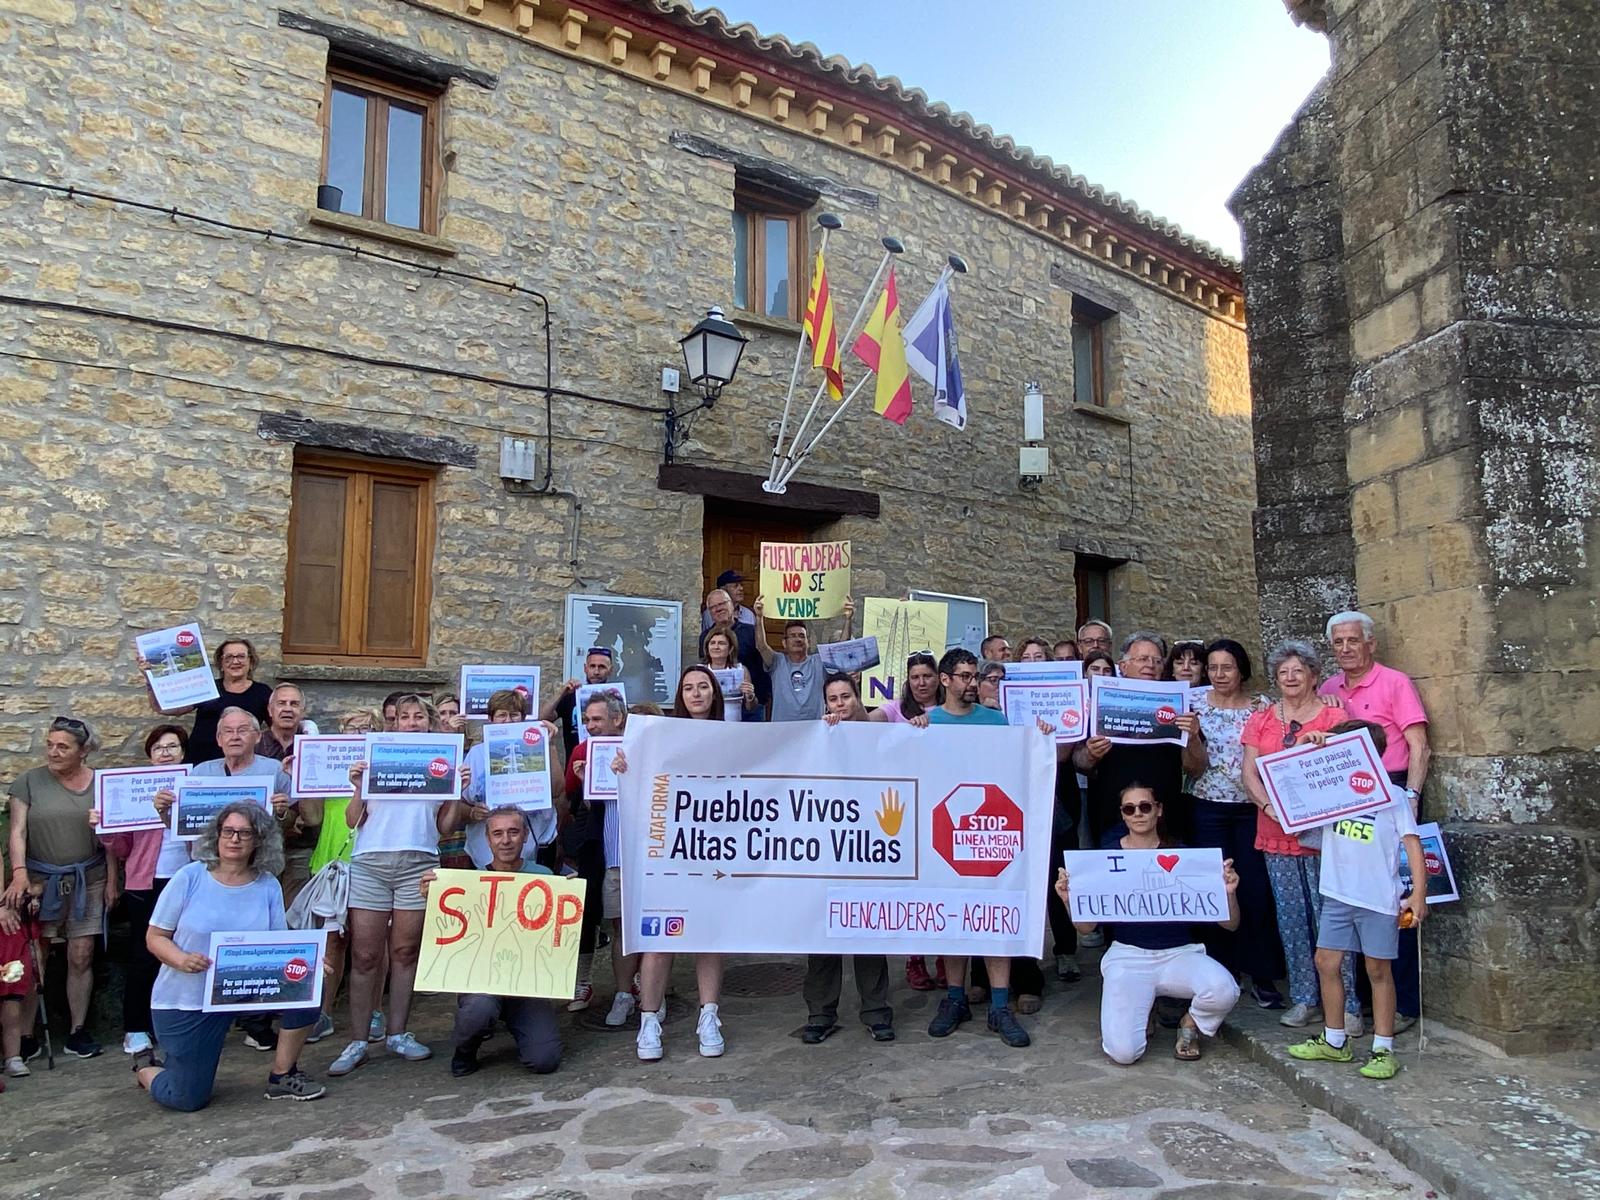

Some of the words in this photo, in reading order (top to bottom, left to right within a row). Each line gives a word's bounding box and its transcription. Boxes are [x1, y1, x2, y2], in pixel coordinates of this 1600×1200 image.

[762, 542, 850, 572] FUENCALDERAS
[782, 573, 802, 593] NO
[808, 572, 826, 592] SE
[776, 597, 821, 618] VENDE
[177, 635, 194, 644] STOP
[1063, 713, 1079, 725] STOP
[1157, 710, 1176, 720] STOP
[525, 731, 541, 741] STOP
[1298, 760, 1312, 769] Por
[1314, 757, 1325, 765] un
[1325, 748, 1353, 765] paisaje
[1322, 766, 1335, 775] sin
[1336, 758, 1361, 771] cables
[431, 762, 448, 772] STOP
[1308, 781, 1317, 790] ni
[1318, 775, 1344, 789] peligro
[1351, 776, 1374, 788] STOP
[674, 789, 779, 823] Pueblos
[788, 788, 860, 823] Vivos
[648, 773, 671, 859] PLATAFORMA
[968, 815, 1008, 831] STOP
[988, 834, 1019, 846] MEDIA
[1335, 819, 1374, 845] 1965
[670, 827, 737, 861] Altas
[747, 827, 820, 862] Cinco
[830, 828, 901, 863] Villas
[970, 846, 1015, 859] TENSION
[1107, 855, 1127, 873] I
[1425, 860, 1440, 869] STOP
[436, 876, 583, 948] STOP
[1077, 892, 1220, 917] FUENCALDERAS
[829, 901, 946, 932] FUENCALDERAS
[286, 964, 307, 975] STOP
[223, 978, 234, 987] Por
[243, 977, 265, 988] paisaje
[232, 987, 252, 995] cables
[259, 986, 281, 996] peligro
